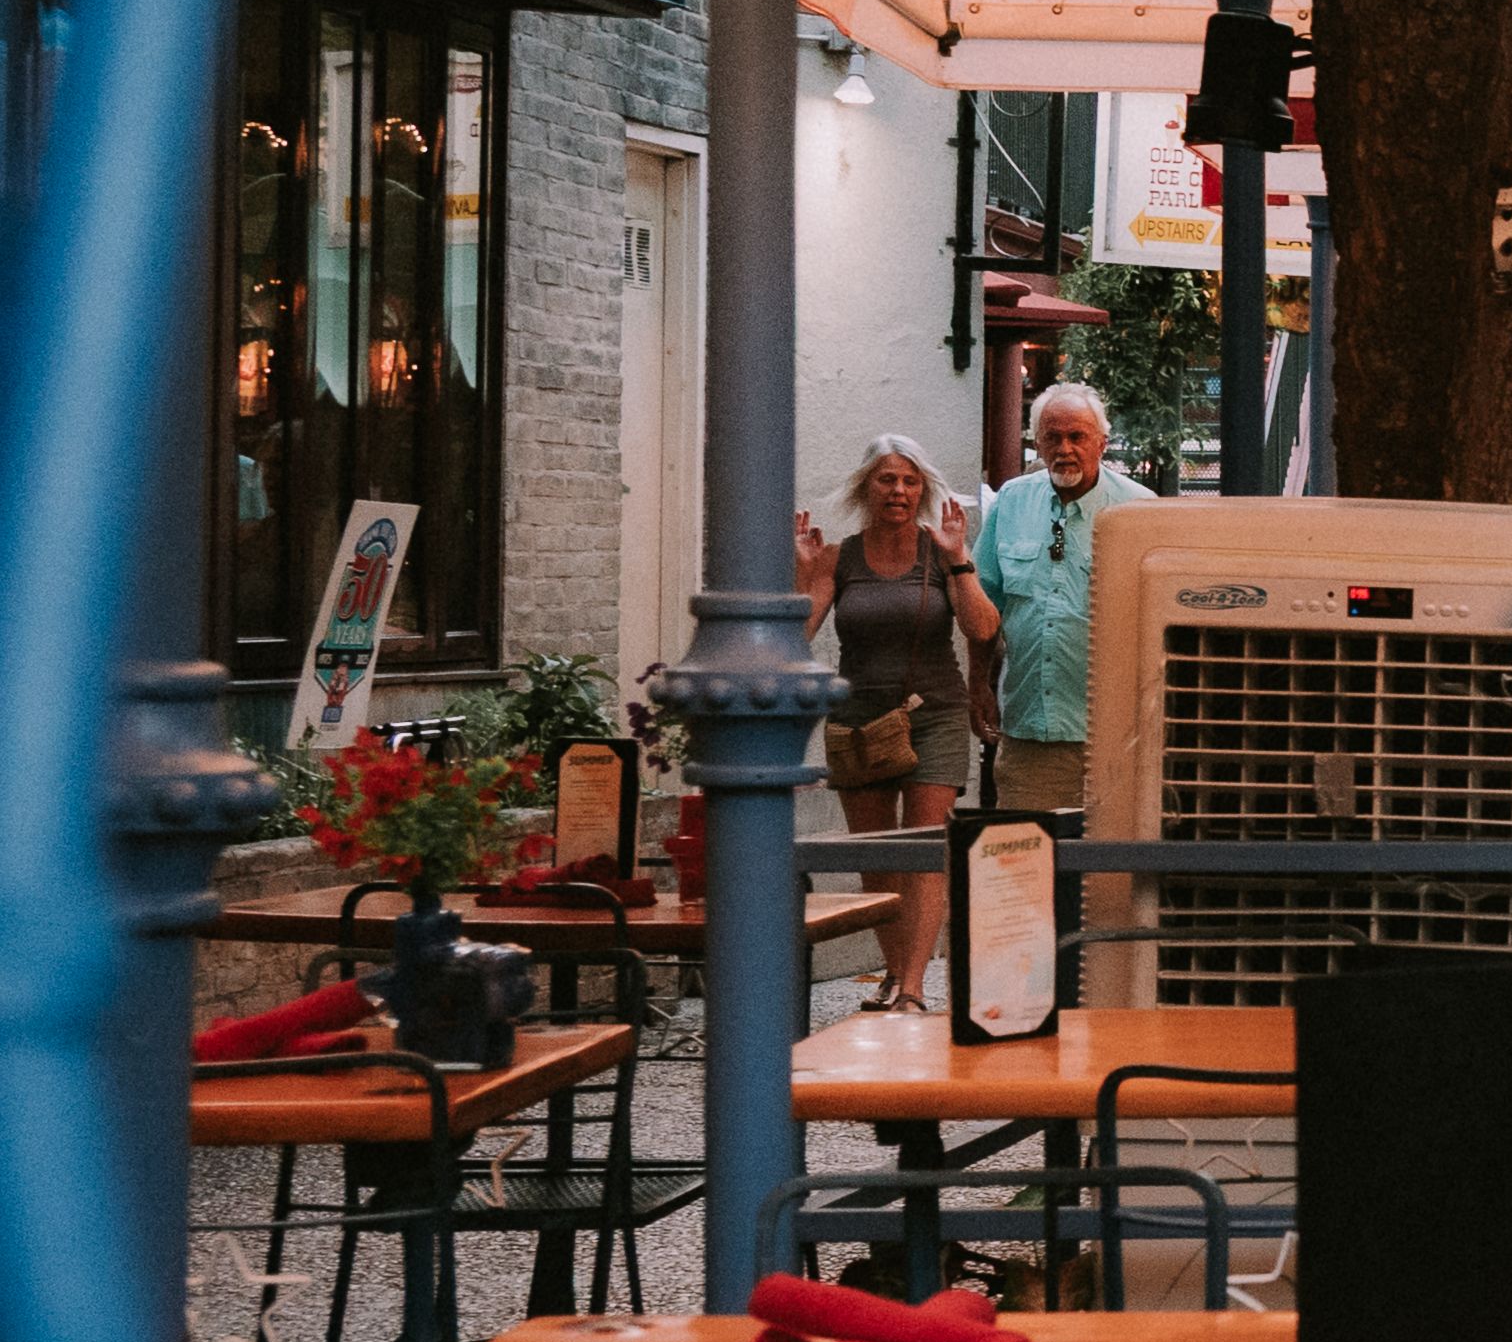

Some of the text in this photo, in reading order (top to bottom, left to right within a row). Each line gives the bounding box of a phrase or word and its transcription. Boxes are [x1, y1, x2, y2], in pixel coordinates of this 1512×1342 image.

[1150, 147, 1184, 164] OLD
[1150, 169, 1180, 187] ICE
[1148, 190, 1202, 208] PARL
[1137, 220, 1206, 241] UPSTAIRS
[981, 836, 1042, 858] SUMMER
